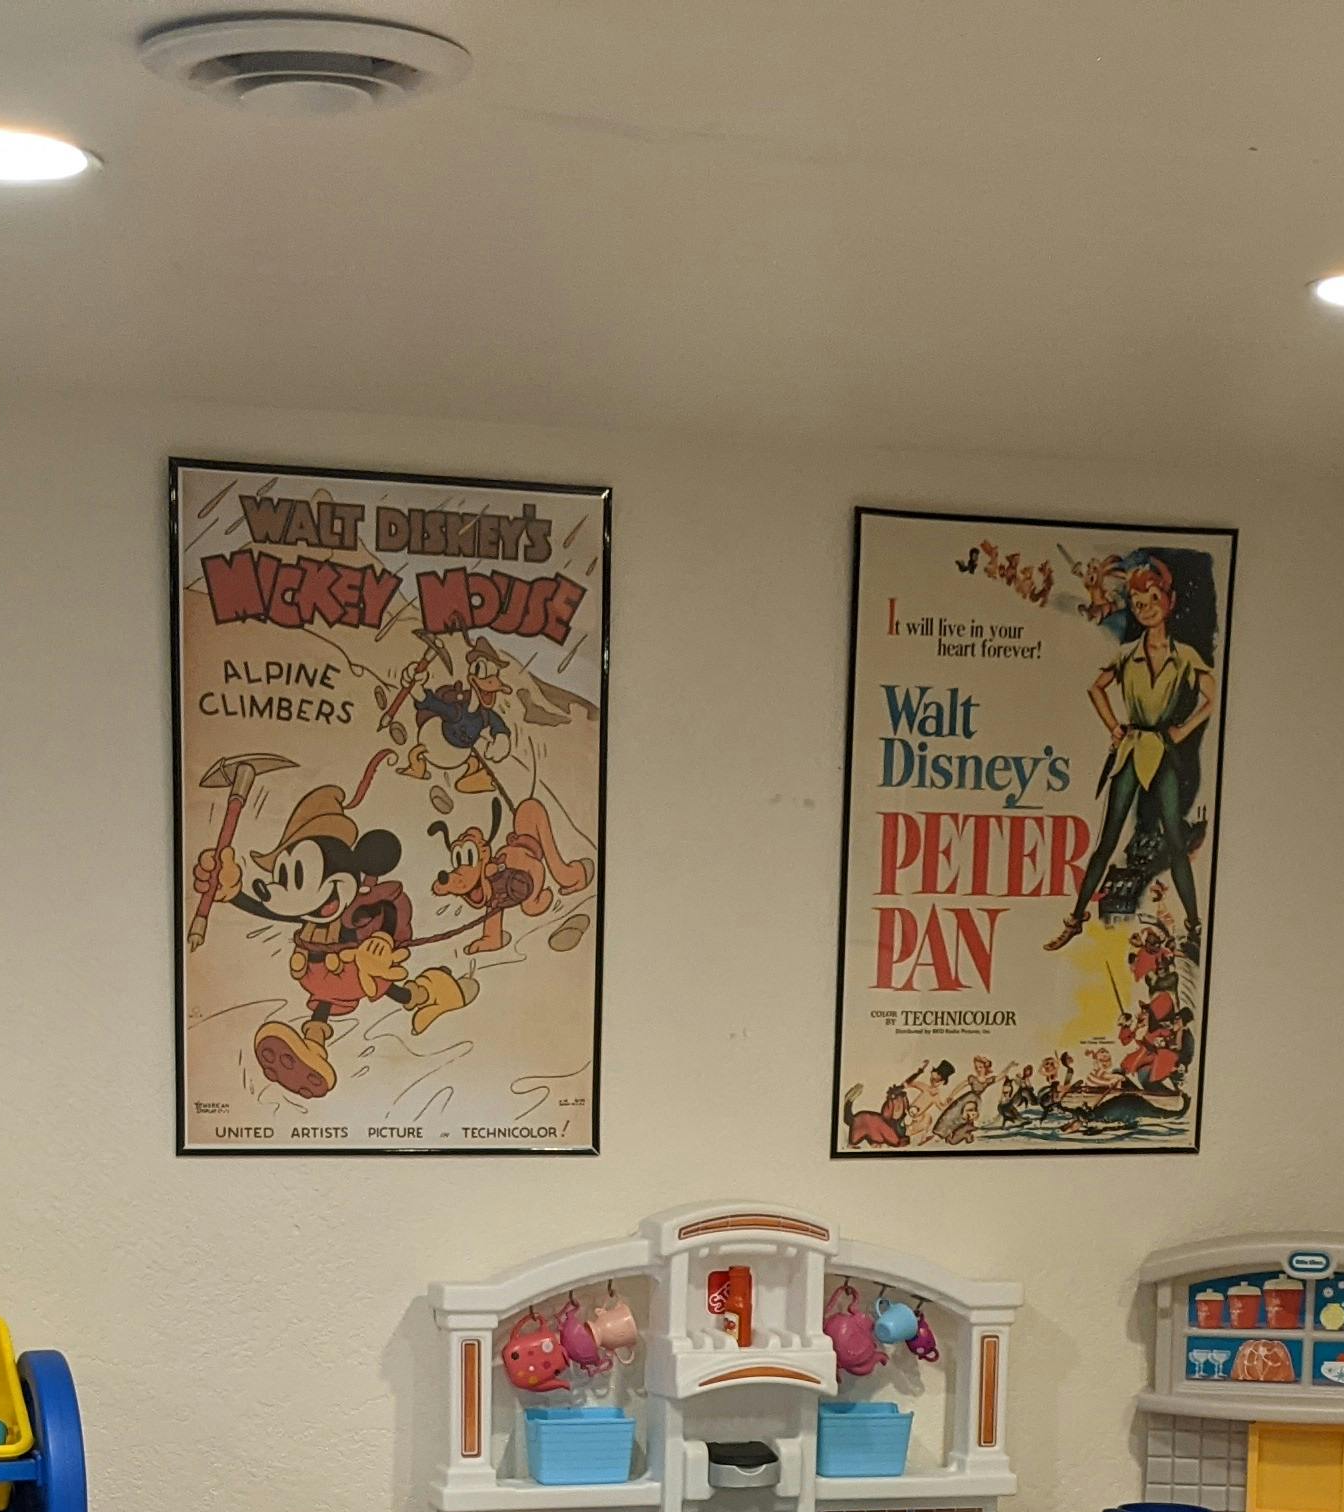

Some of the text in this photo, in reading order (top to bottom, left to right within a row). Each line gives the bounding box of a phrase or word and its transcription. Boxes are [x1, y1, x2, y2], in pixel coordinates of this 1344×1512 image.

[239, 495, 552, 563] WALT DISNEY'S
[200, 548, 587, 646] MICKEY MOUSE
[886, 598, 1024, 642] It will live in your
[937, 638, 1042, 660] heart forever!
[223, 660, 342, 689] ALPINE
[198, 692, 354, 725] CLIMBERS
[880, 684, 981, 740] Walt
[877, 736, 1071, 810] Disney's
[872, 811, 1093, 898] PETER
[868, 903, 1011, 993] PAN
[870, 1010, 898, 1019] COLOR
[900, 1010, 1017, 1026] TECHNICOLOR
[215, 1127, 274, 1138] UNITED
[291, 1127, 349, 1139] ARTISTS
[368, 1127, 424, 1138] PICTURE
